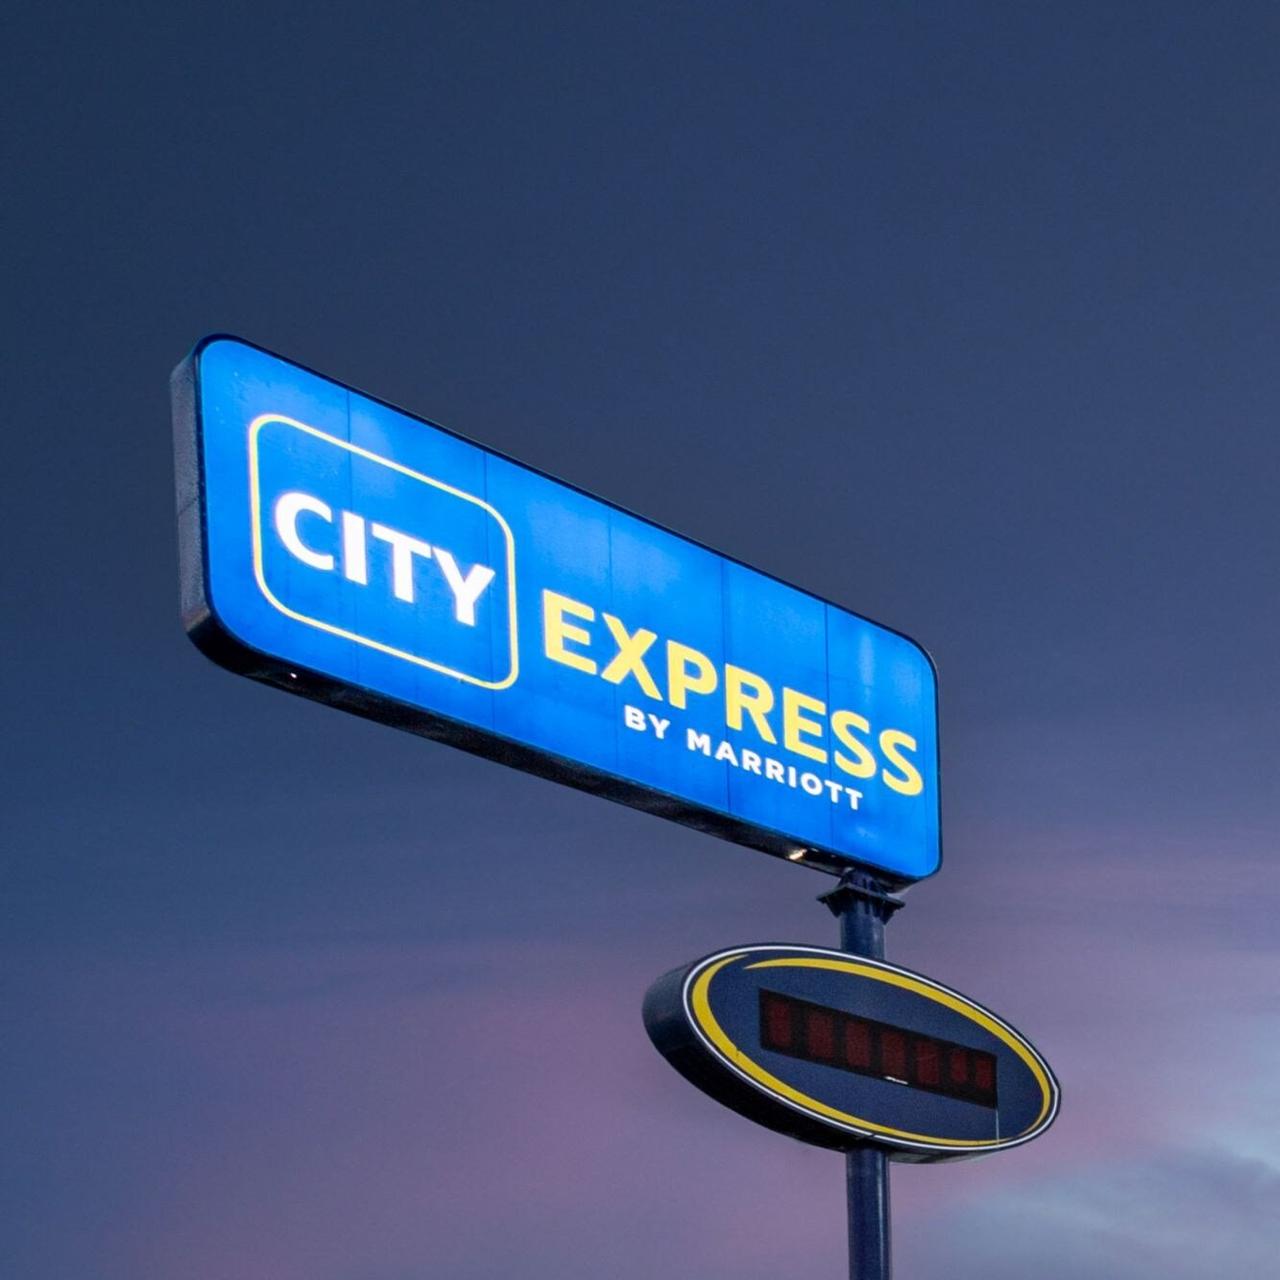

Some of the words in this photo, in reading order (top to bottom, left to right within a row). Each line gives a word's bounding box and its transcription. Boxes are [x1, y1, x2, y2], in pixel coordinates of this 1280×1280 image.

[274, 490, 496, 628] CITY
[542, 589, 926, 797] EXPRESS
[624, 703, 670, 740] BY
[686, 732, 864, 811] MARRIOTT
